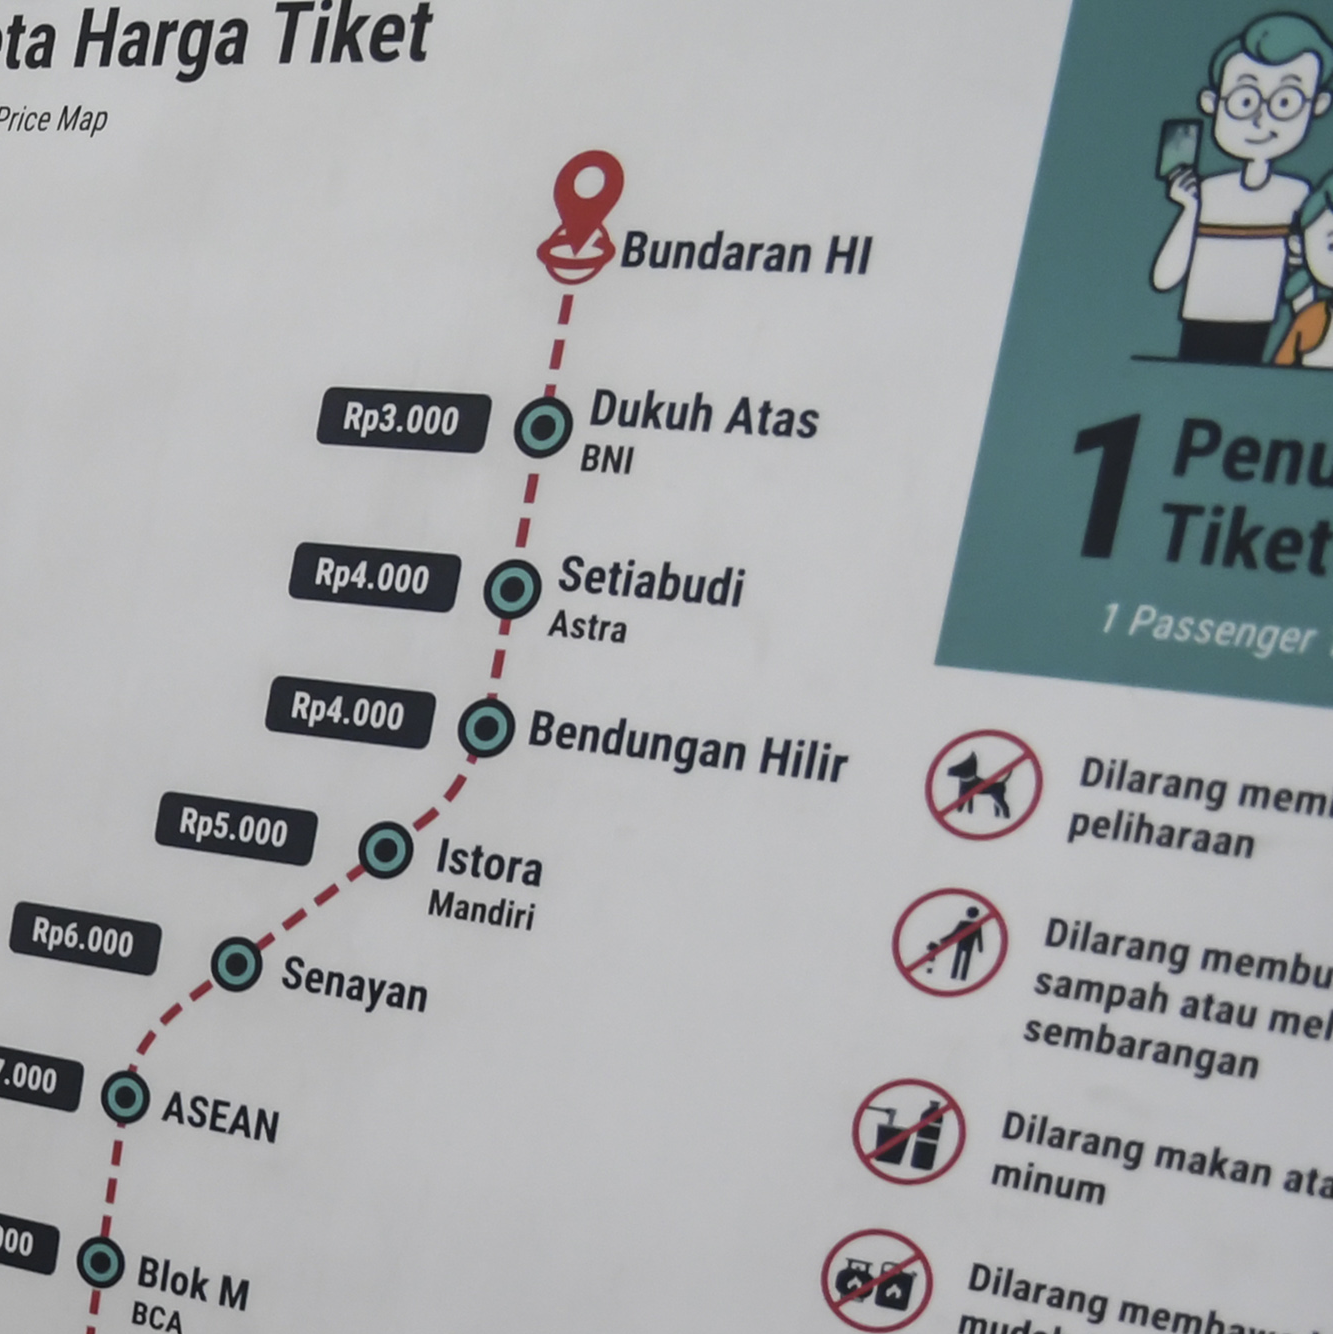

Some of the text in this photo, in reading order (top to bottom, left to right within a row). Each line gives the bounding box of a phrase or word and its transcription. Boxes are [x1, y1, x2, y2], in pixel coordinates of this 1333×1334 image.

[73, 6, 249, 84] Harga
[274, 0, 434, 65] Tiket
[56, 104, 109, 139] Map
[620, 229, 874, 275] Bundaran HI
[343, 401, 460, 439] Rp3.000
[589, 388, 820, 439] Dukuh Atas
[580, 443, 635, 475] BNI
[1073, 413, 1141, 560] 1
[1162, 502, 1333, 577] Tiket
[314, 556, 430, 595] Rp4.000
[558, 555, 746, 608] Setiabudi
[547, 609, 628, 644] Astra
[1103, 602, 1318, 660] 1 Passenger
[290, 690, 405, 731] Rp4.000
[528, 709, 850, 783] Bendungan Hilir
[1080, 756, 1228, 812] Dilarang
[179, 806, 288, 848] Rp5.000
[1067, 809, 1255, 859] peliharaan
[436, 837, 543, 888] Istora
[427, 888, 536, 931] Mandiri
[32, 915, 134, 958] Rp6.000
[1044, 917, 1191, 975] Dilarang
[281, 955, 428, 1014] Senayan
[1034, 972, 1258, 1029] sampah atau
[1023, 1019, 1260, 1080] sembarangan
[161, 1090, 280, 1144] ASEAN
[1001, 1110, 1272, 1188] Dilarang makan
[991, 1162, 1107, 1206] minum
[137, 1255, 250, 1312] Blok M
[968, 1262, 1109, 1325] Dilarang
